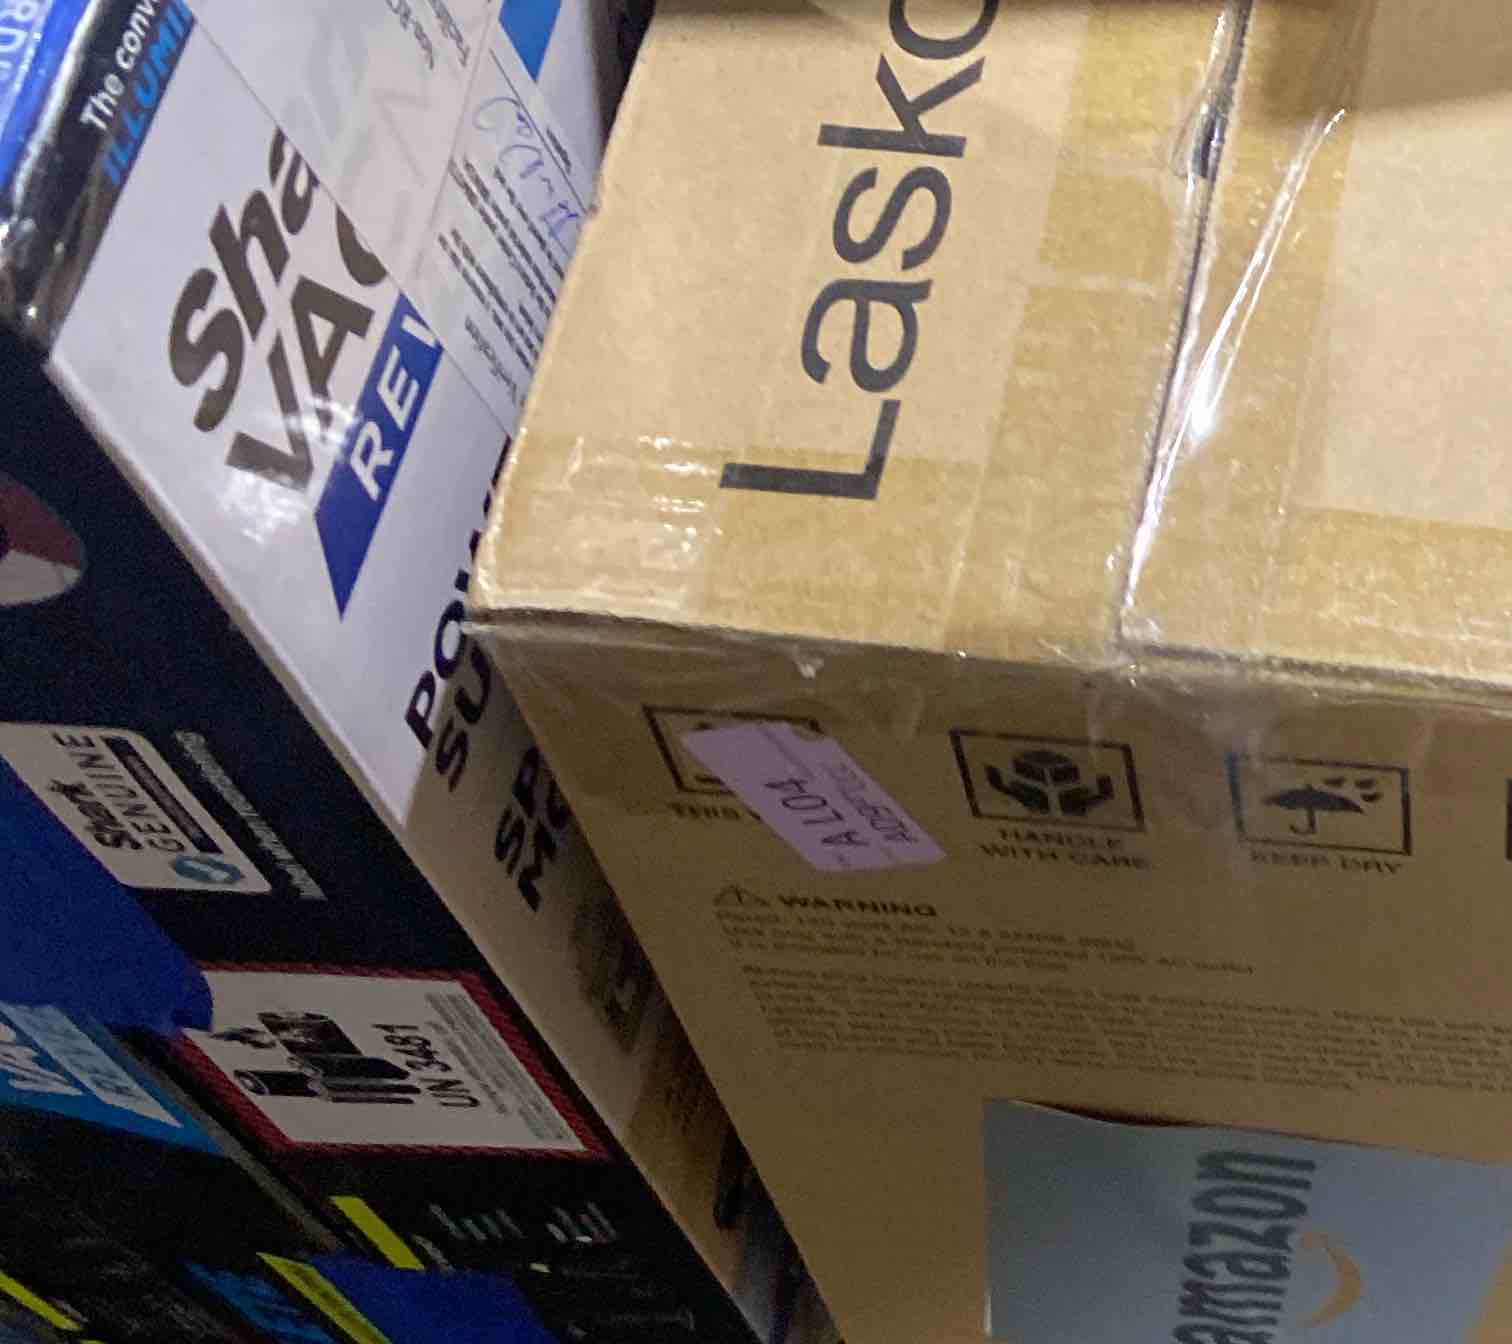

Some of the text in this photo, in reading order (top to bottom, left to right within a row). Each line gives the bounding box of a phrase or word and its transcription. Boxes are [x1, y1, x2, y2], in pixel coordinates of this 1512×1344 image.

[80, 71, 121, 131] The
[978, 844, 1057, 864] WITH
[778, 895, 938, 918] WARNING
